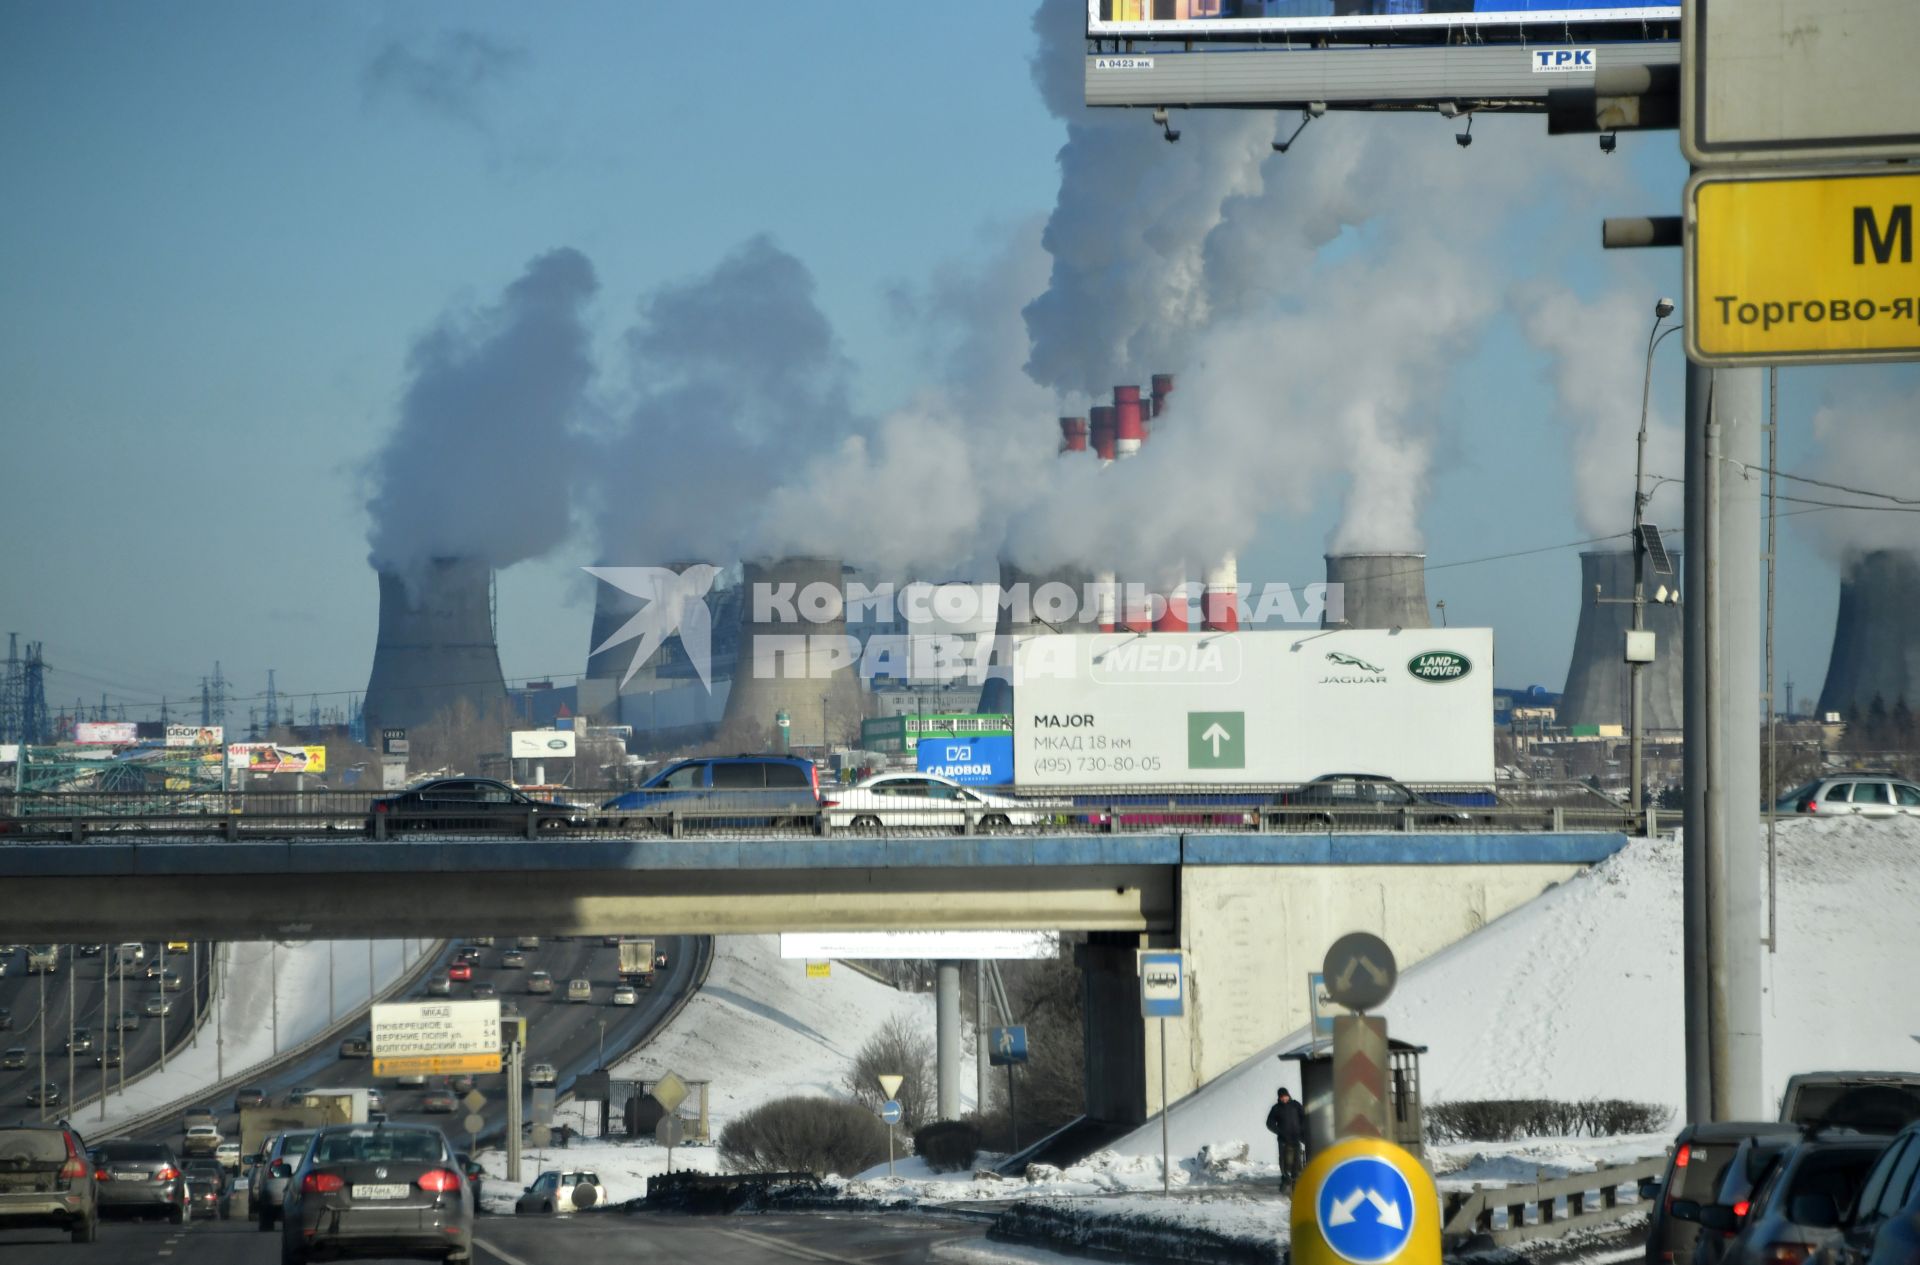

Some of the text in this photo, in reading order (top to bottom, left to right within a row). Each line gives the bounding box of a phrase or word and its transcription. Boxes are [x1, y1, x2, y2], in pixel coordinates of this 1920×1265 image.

[1109, 59, 1134, 68] 0423
[1536, 50, 1592, 66] ТРК
[1714, 296, 1920, 332] Торгово-я
[1420, 656, 1451, 666] LAND
[1423, 666, 1461, 676] ROVER
[1318, 676, 1387, 684] JAGUAR
[1034, 714, 1095, 728] MAJOR
[167, 728, 198, 737] ОБОИ
[1034, 735, 1083, 751] МКАД
[1089, 735, 1107, 749] 18
[927, 765, 991, 776] САДОВОД
[1034, 756, 1161, 776] (495) 730-80-05
